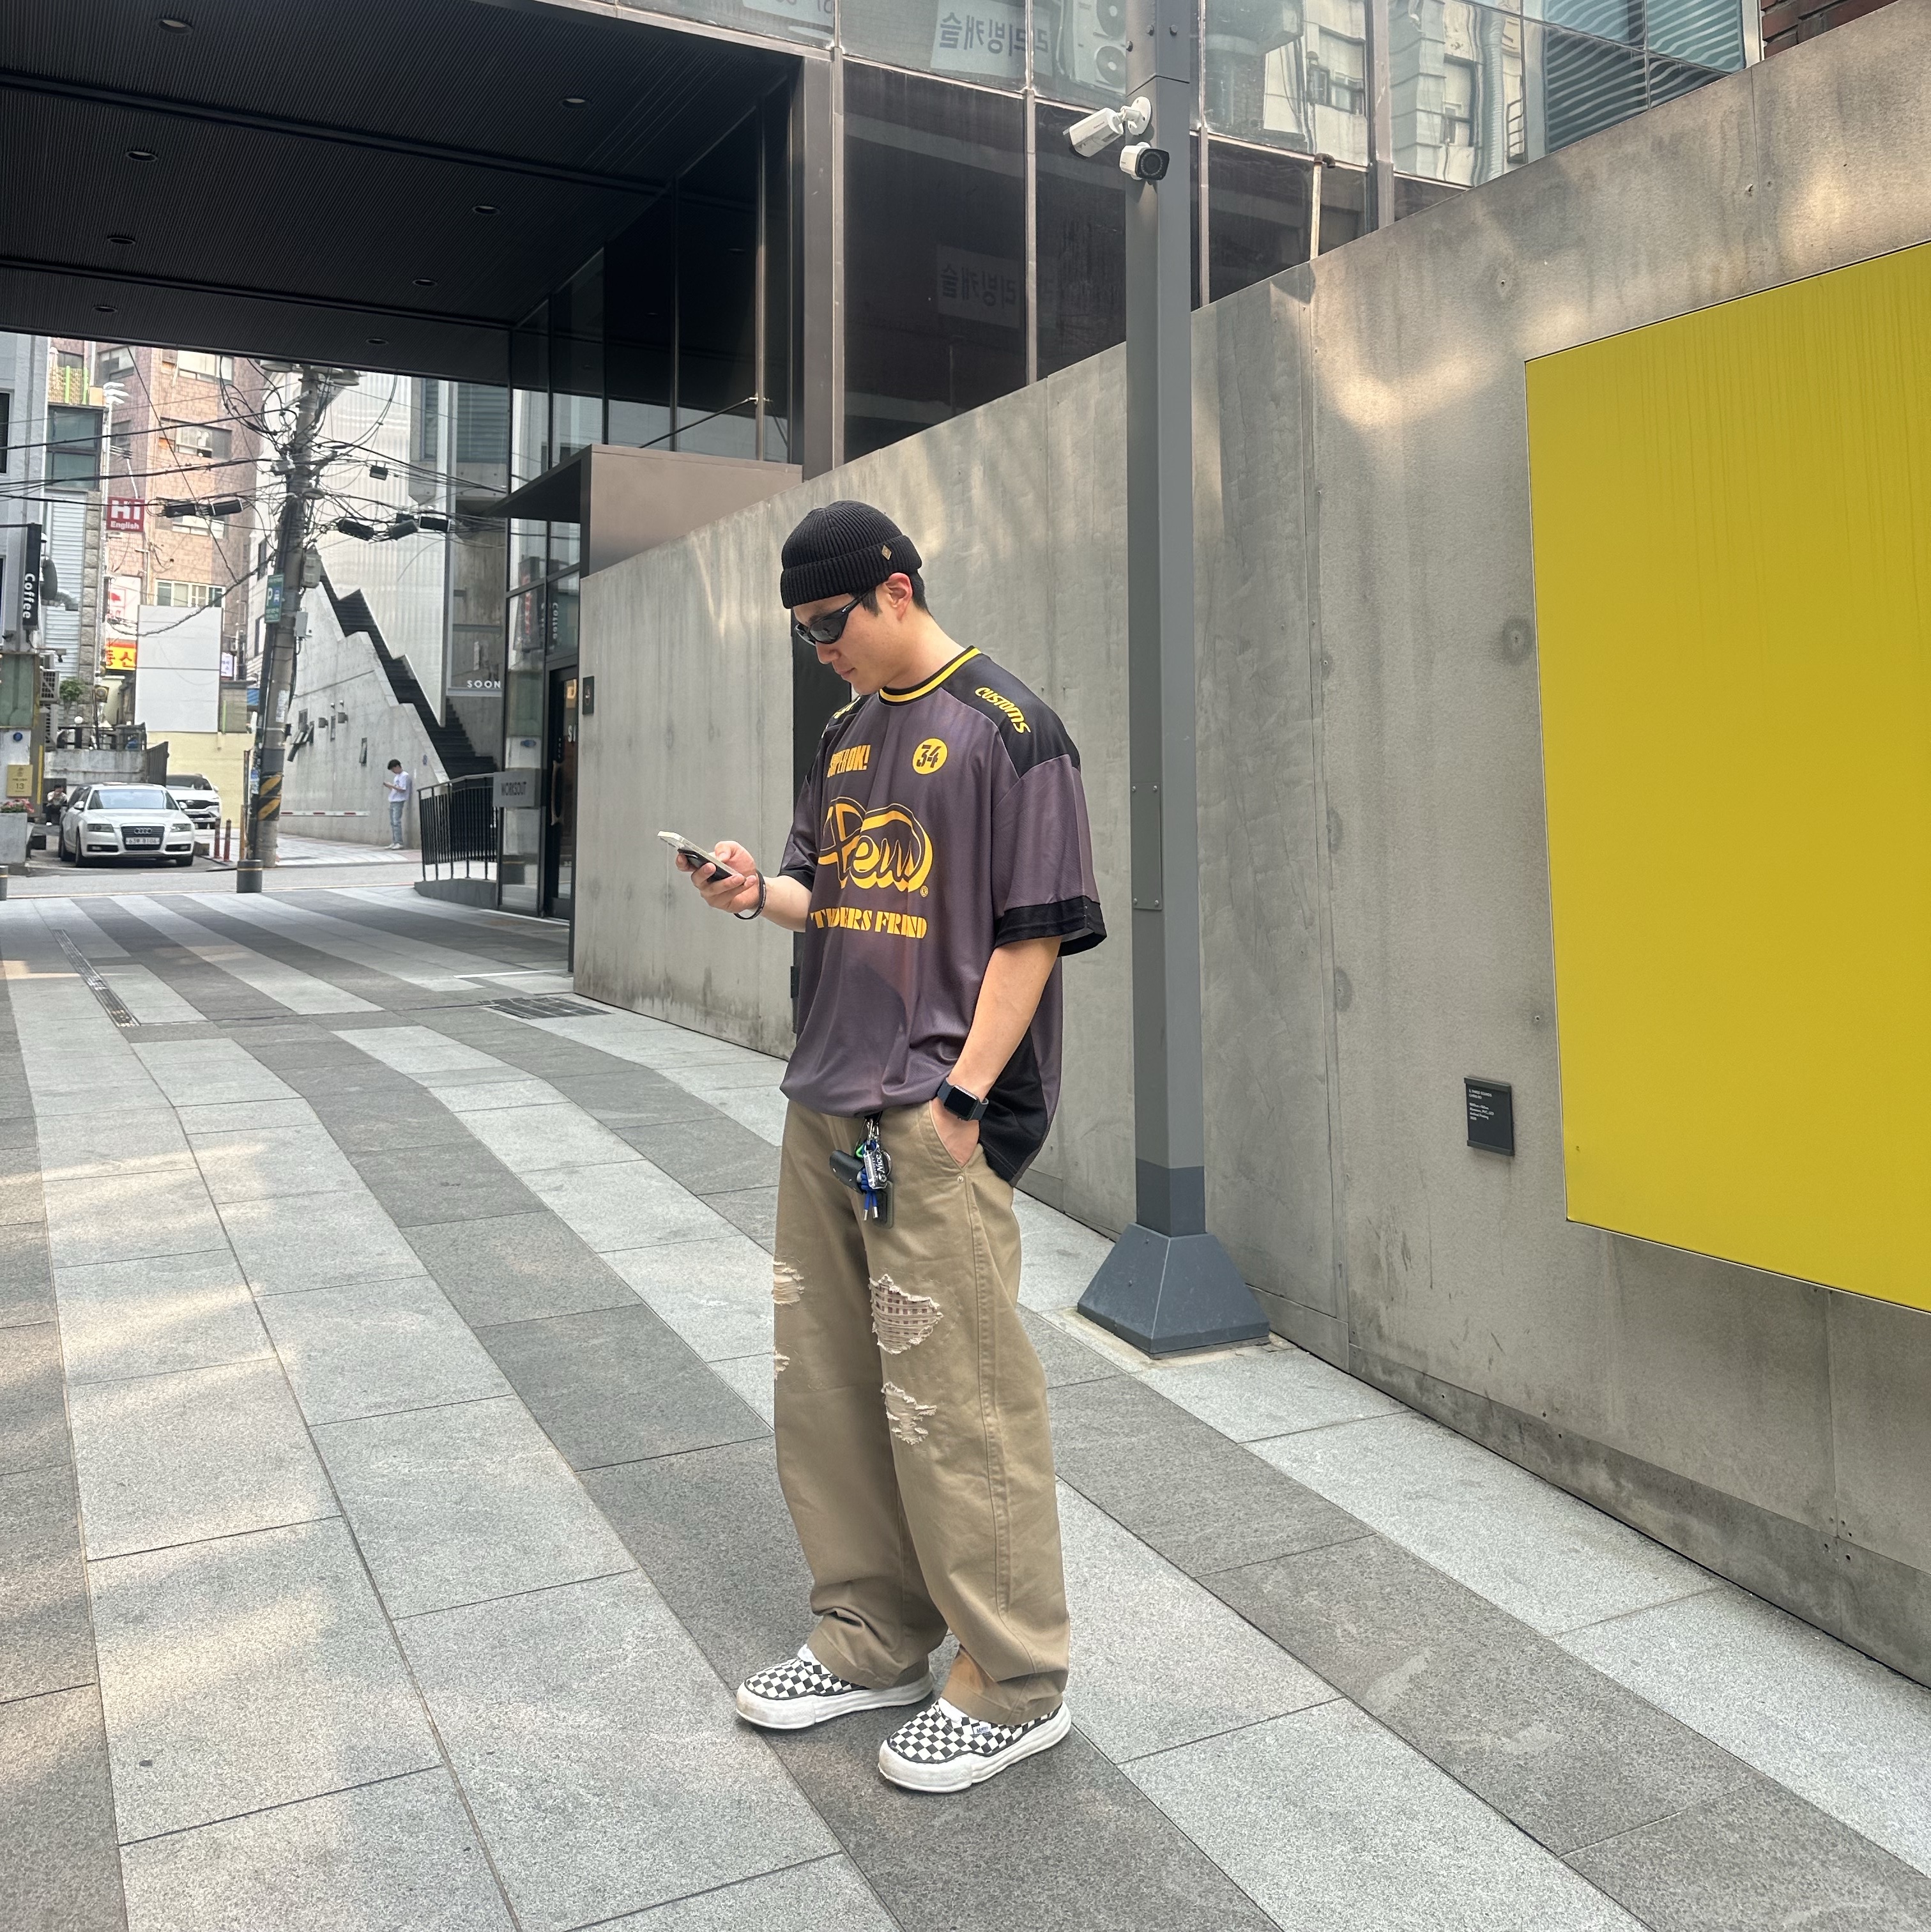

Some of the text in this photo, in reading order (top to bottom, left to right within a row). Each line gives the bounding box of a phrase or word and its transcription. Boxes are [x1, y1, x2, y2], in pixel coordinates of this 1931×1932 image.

[111, 521, 139, 530] English
[23, 573, 35, 618] Coffee
[467, 680, 501, 688] SOON
[916, 744, 942, 769] 34
